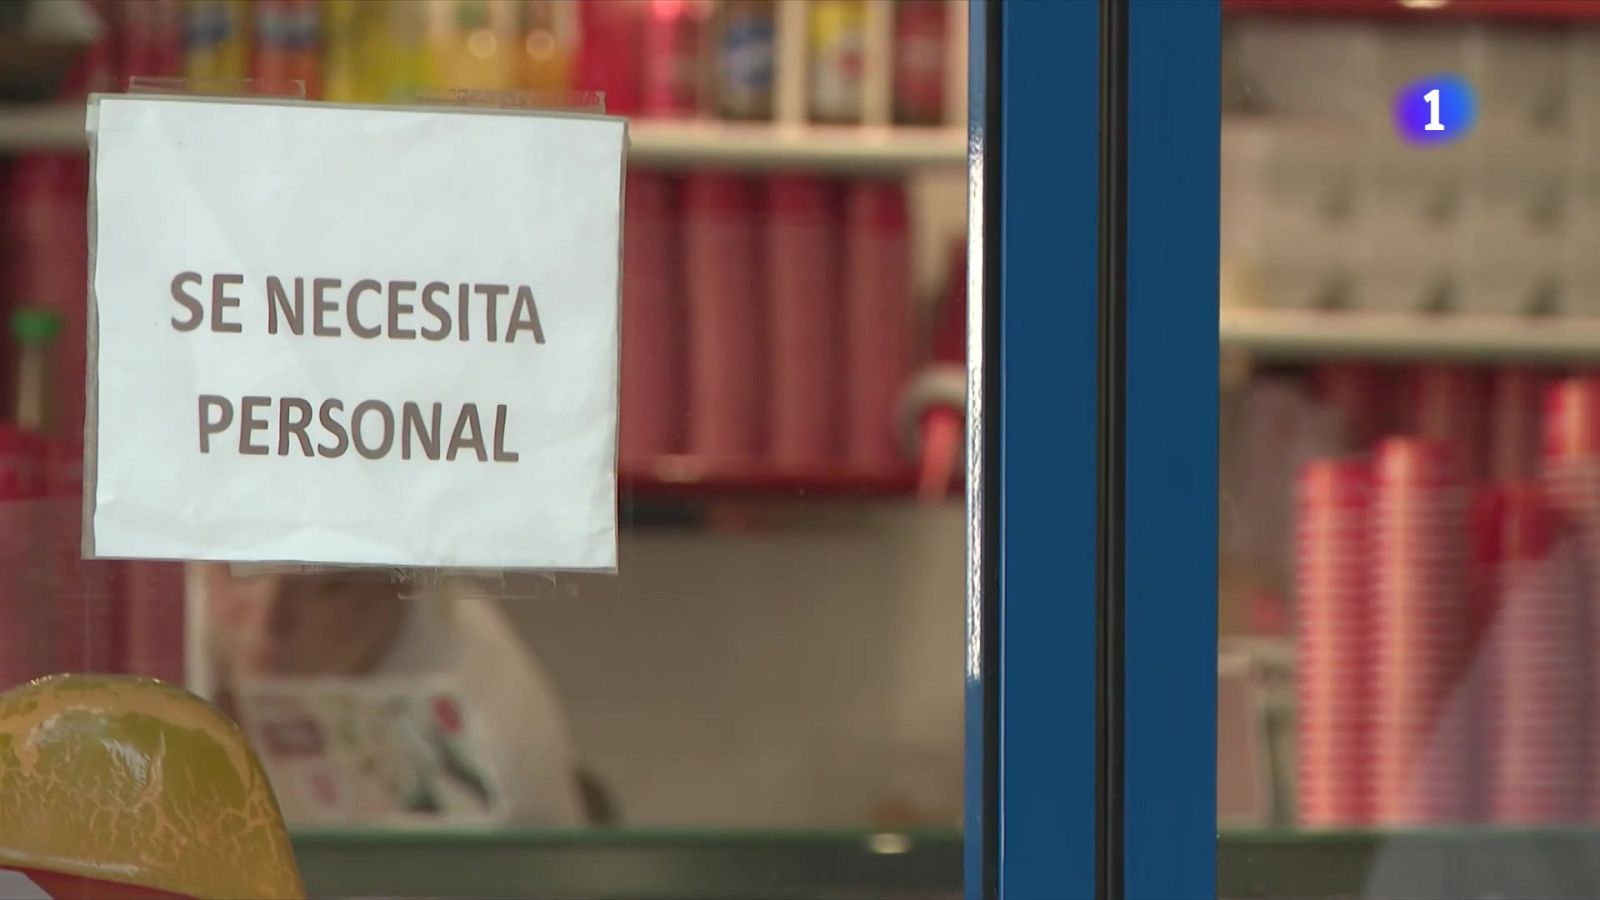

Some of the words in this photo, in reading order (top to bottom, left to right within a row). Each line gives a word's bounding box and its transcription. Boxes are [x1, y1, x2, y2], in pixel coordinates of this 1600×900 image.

[169, 271, 245, 333] SE
[266, 276, 546, 345] NECESITA
[198, 394, 520, 463] PERSONAL
